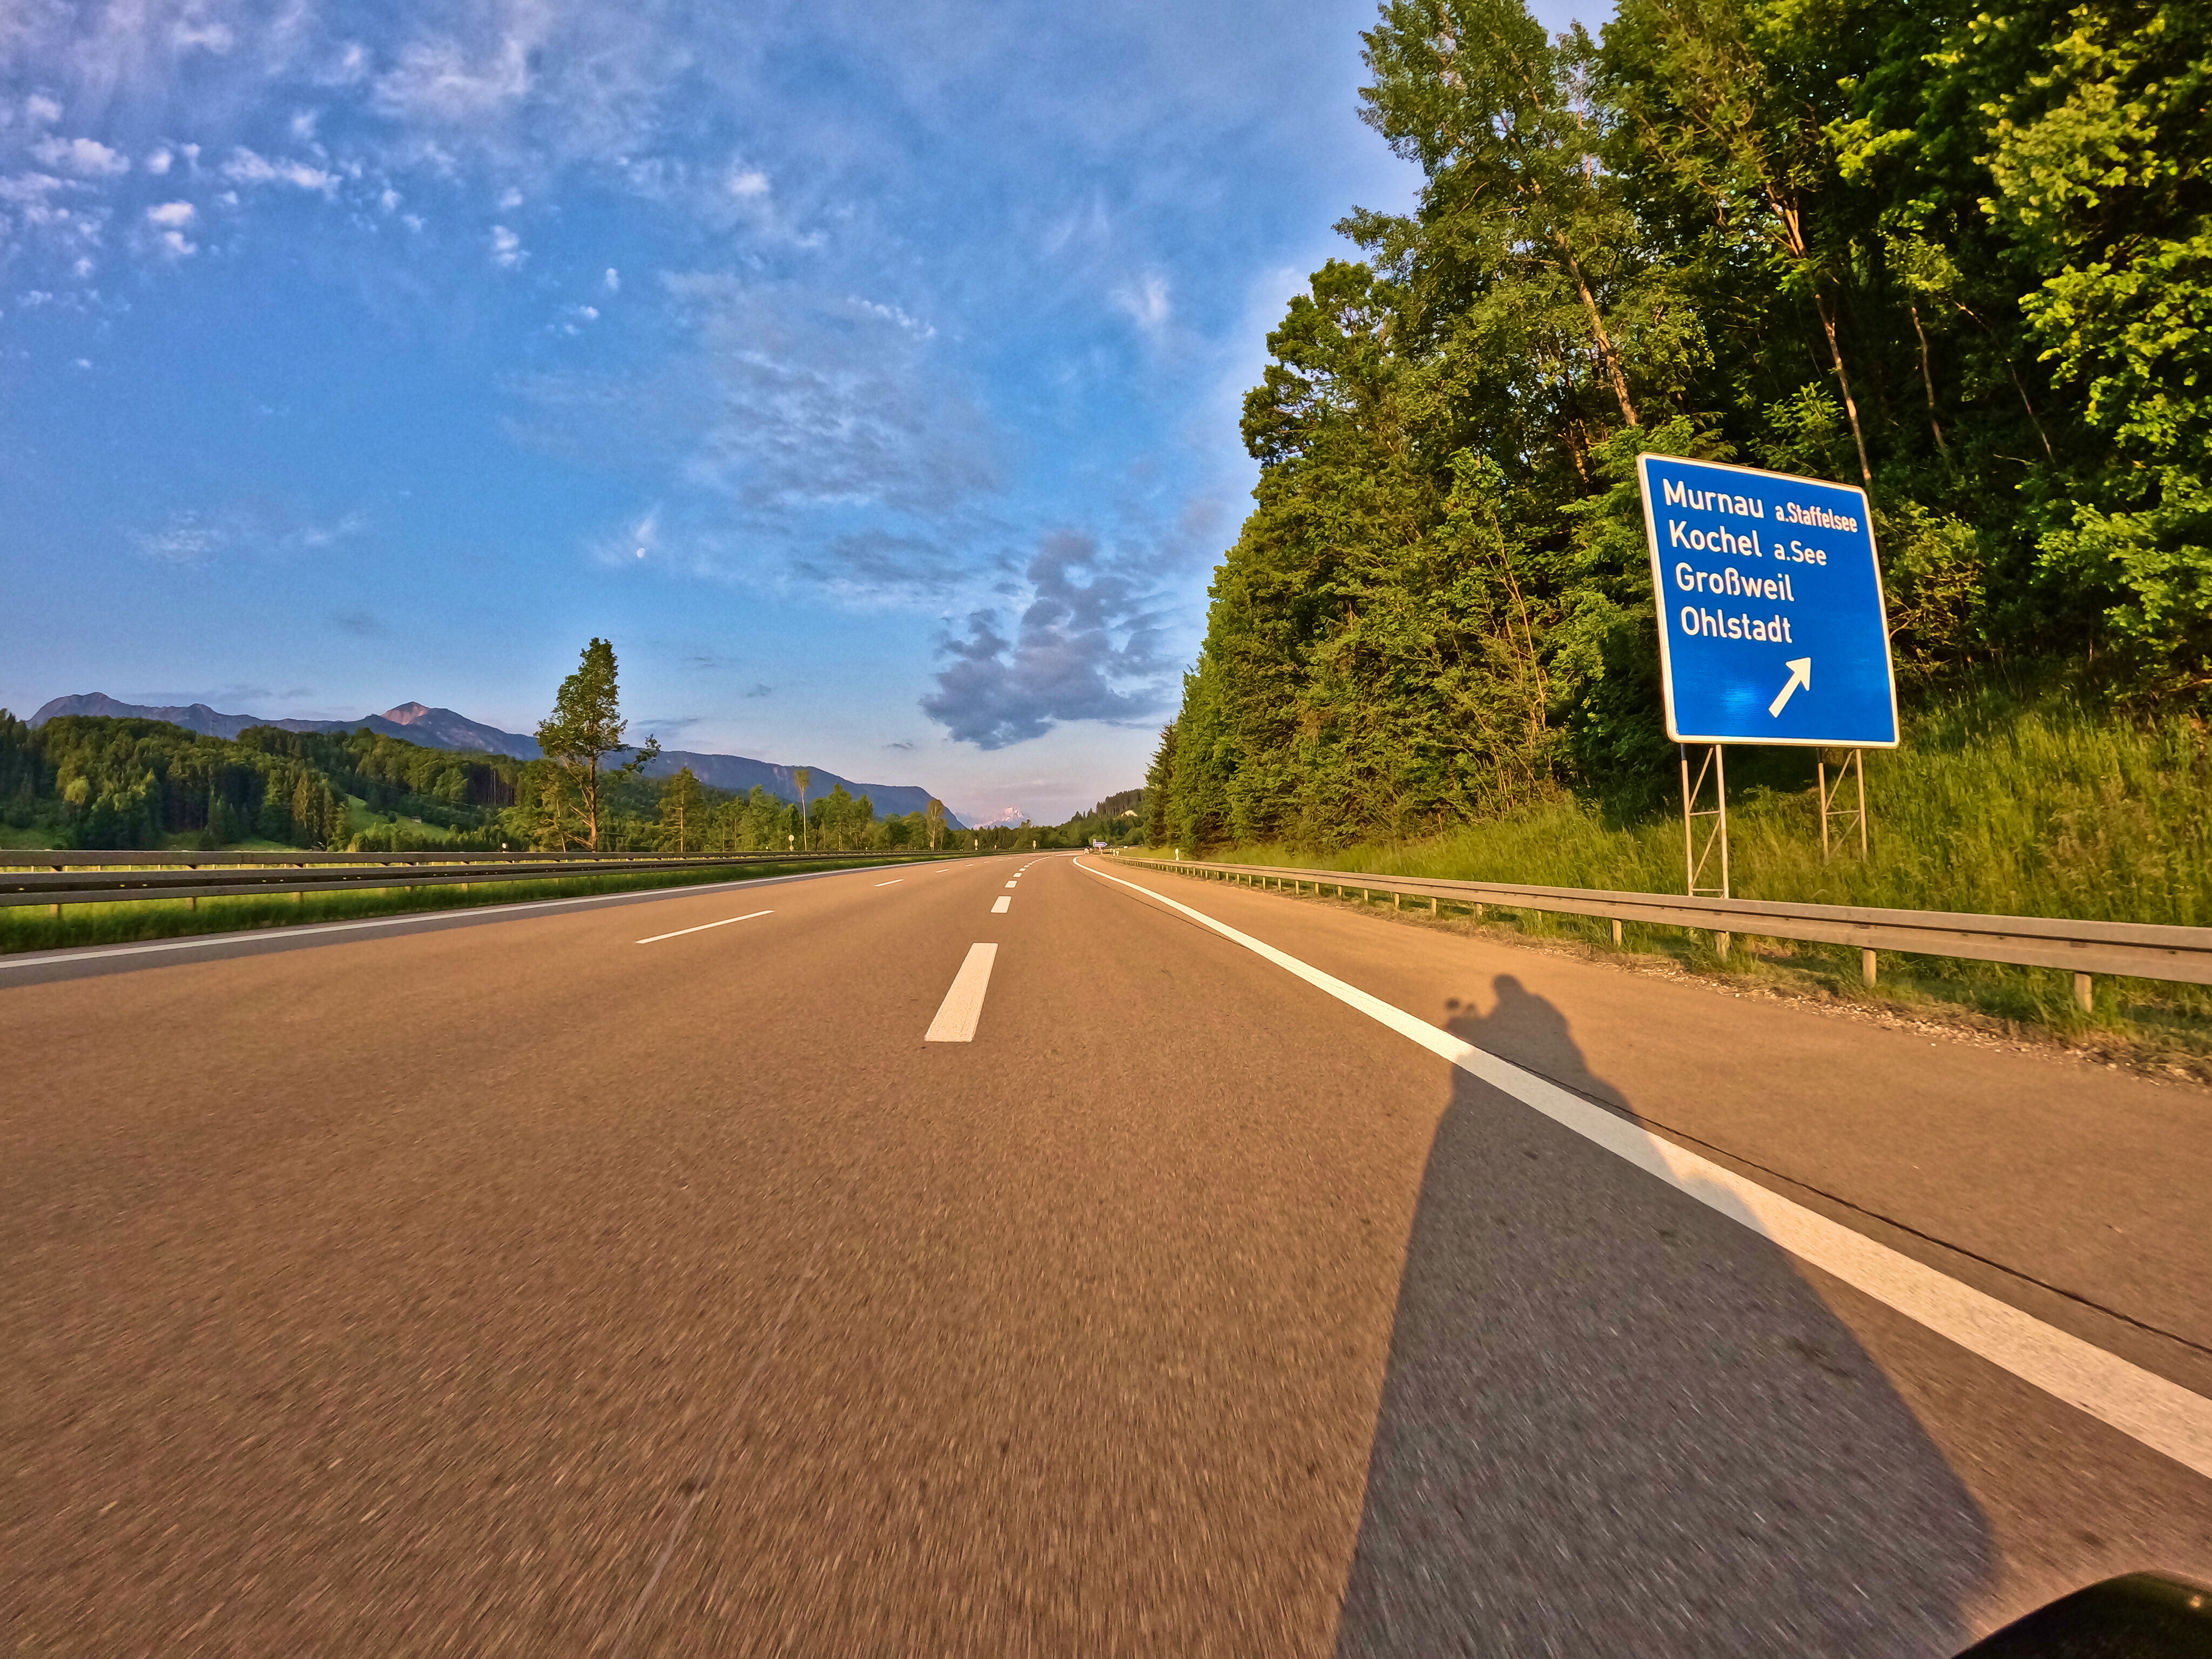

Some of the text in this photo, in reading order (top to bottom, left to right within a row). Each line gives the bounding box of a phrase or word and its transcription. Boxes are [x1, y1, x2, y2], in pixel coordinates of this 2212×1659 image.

[1663, 478, 1764, 518] Murnau
[1669, 519, 1763, 557] Kochel
[1675, 562, 1795, 602] Großweil
[1681, 606, 1792, 643] Ohlstadt
